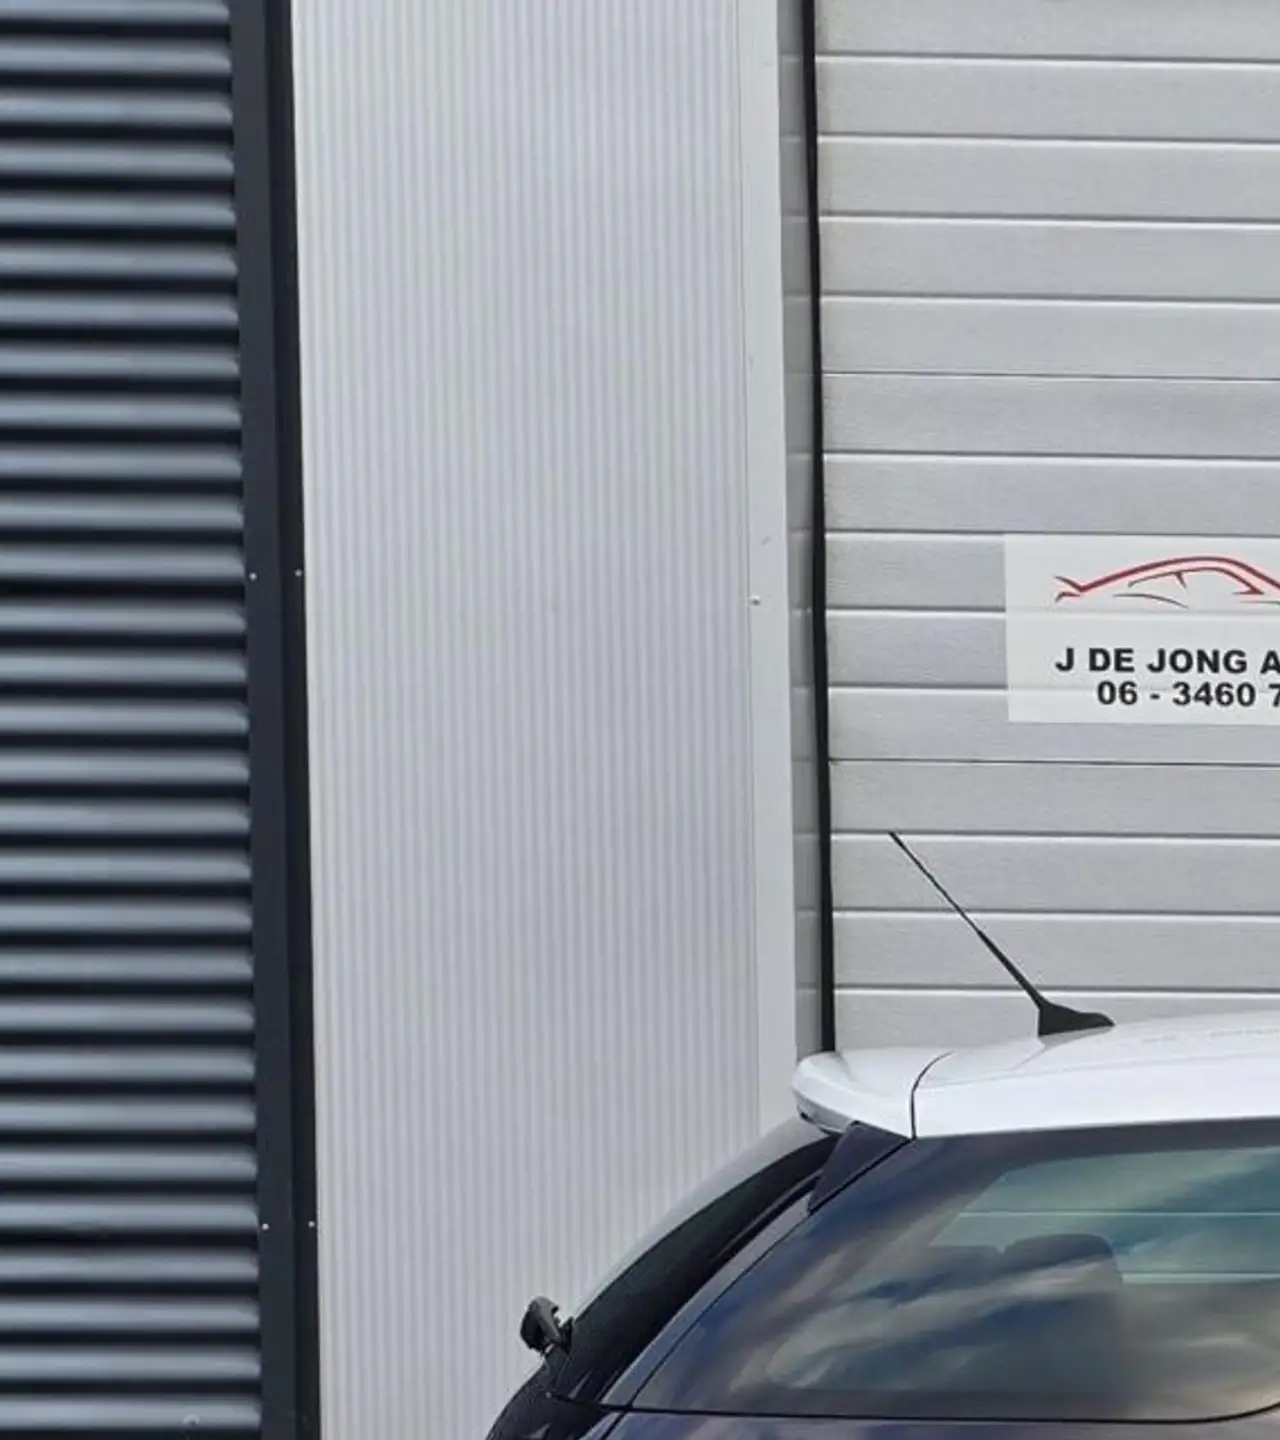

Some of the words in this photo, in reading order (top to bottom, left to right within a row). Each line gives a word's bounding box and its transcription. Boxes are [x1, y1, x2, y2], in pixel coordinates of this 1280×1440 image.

[1055, 647, 1074, 672] J
[1089, 647, 1135, 673] DE
[1147, 648, 1247, 674] JONG
[1097, 680, 1138, 706] 06
[1172, 681, 1256, 707] 3460
